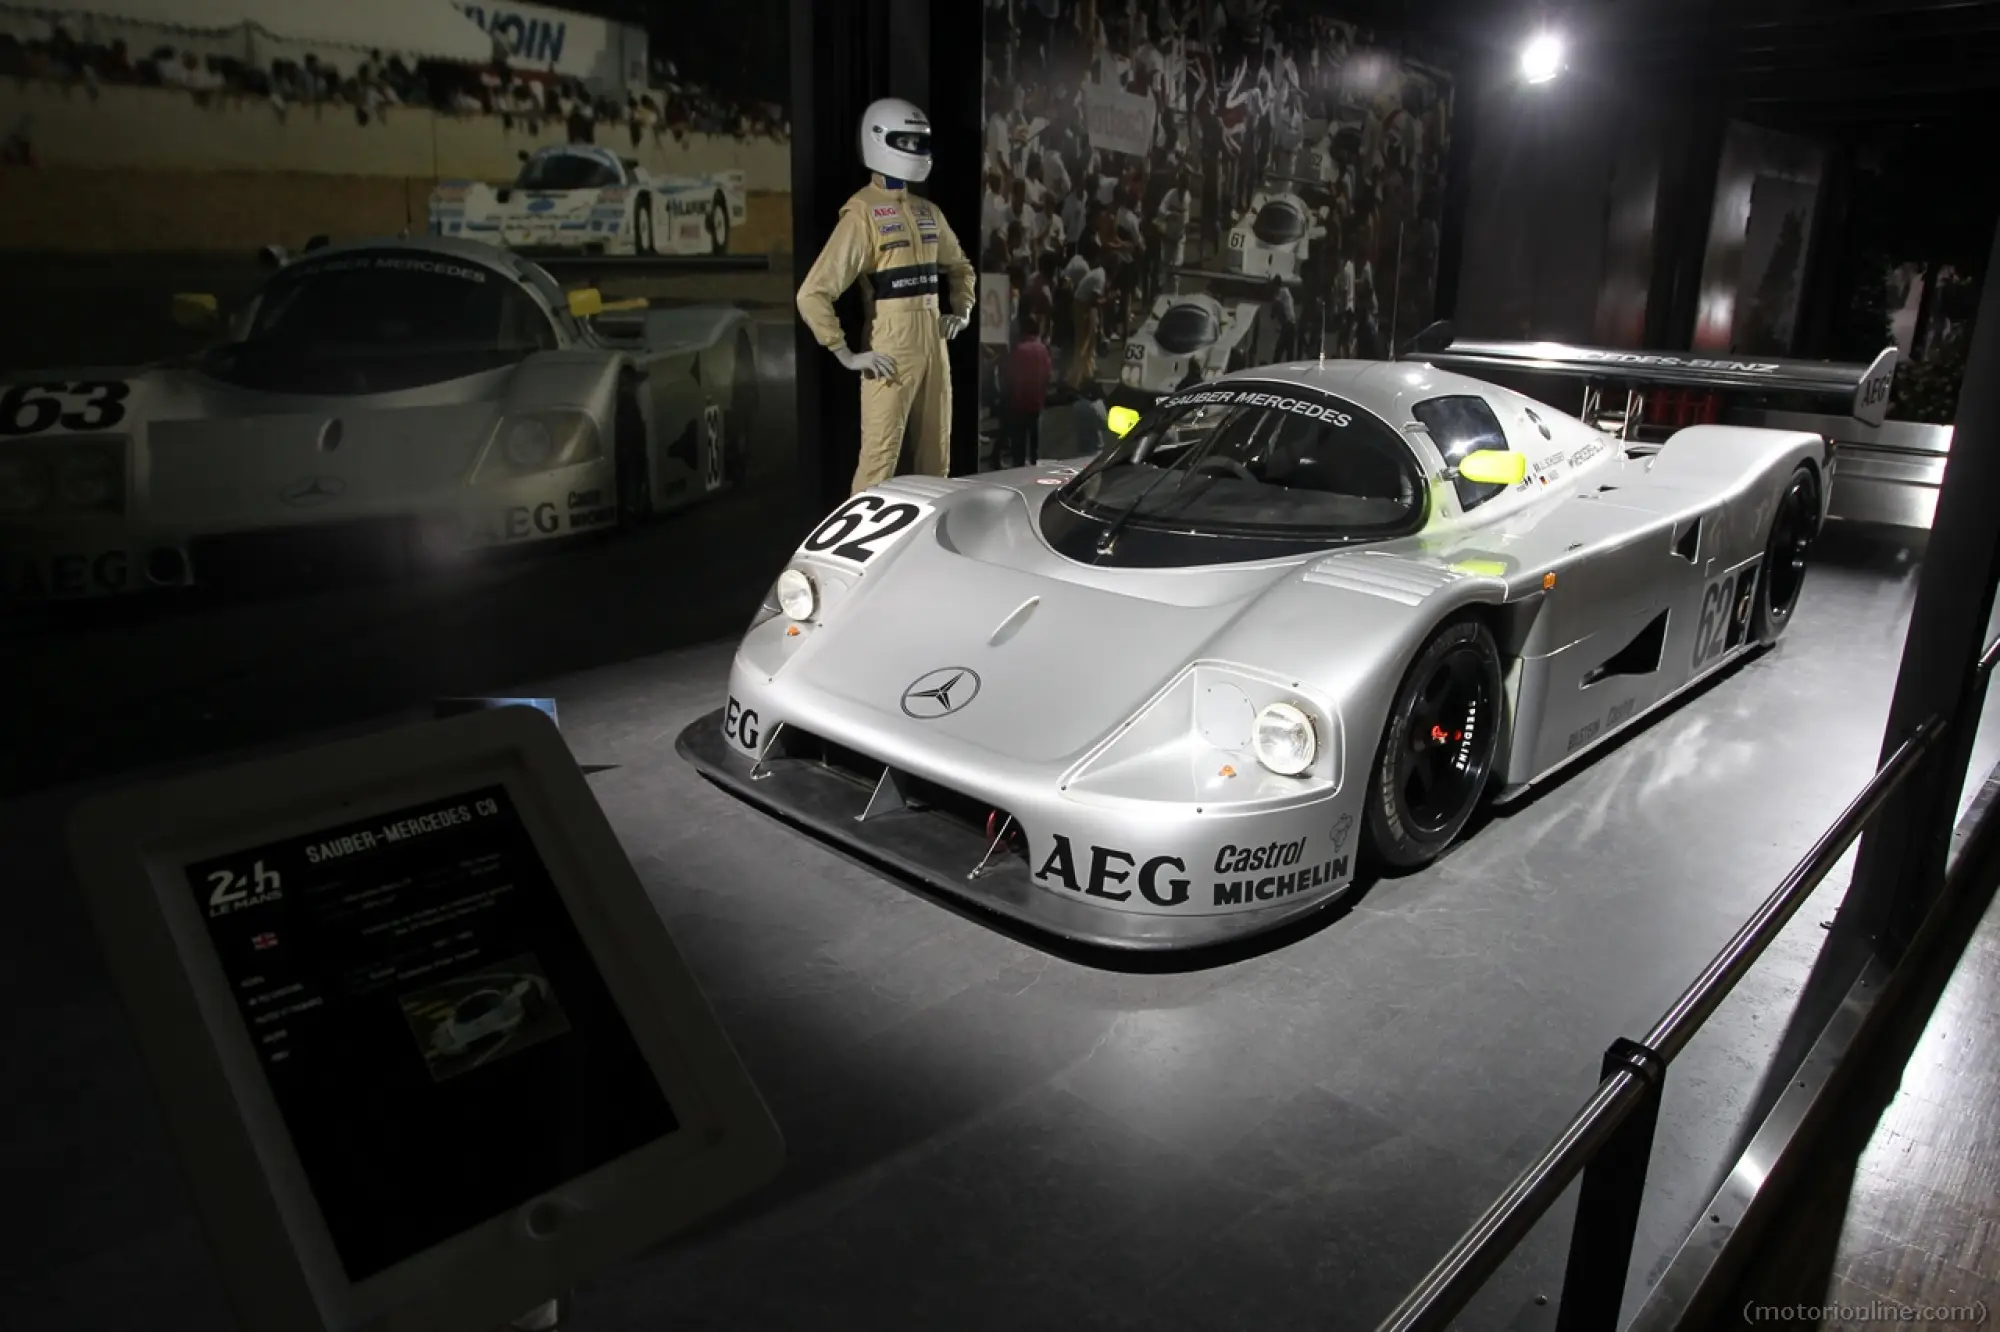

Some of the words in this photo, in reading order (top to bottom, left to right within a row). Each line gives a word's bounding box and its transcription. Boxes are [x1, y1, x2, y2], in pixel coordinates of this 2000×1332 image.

[1231, 233, 1244, 248] 61
[373, 257, 486, 284] MERCEDES
[1125, 344, 1145, 360] 63
[0, 381, 130, 435] 63
[1164, 391, 1235, 409] SAUBER
[1234, 391, 1352, 428] MERCEDES
[804, 496, 921, 563] 62
[1692, 576, 1734, 669] 62
[305, 804, 472, 863] SAUBER-MERCEDES
[1213, 836, 1307, 874] Castrol
[1035, 833, 1191, 907] AEG
[1213, 854, 1349, 906] MICHELIN
